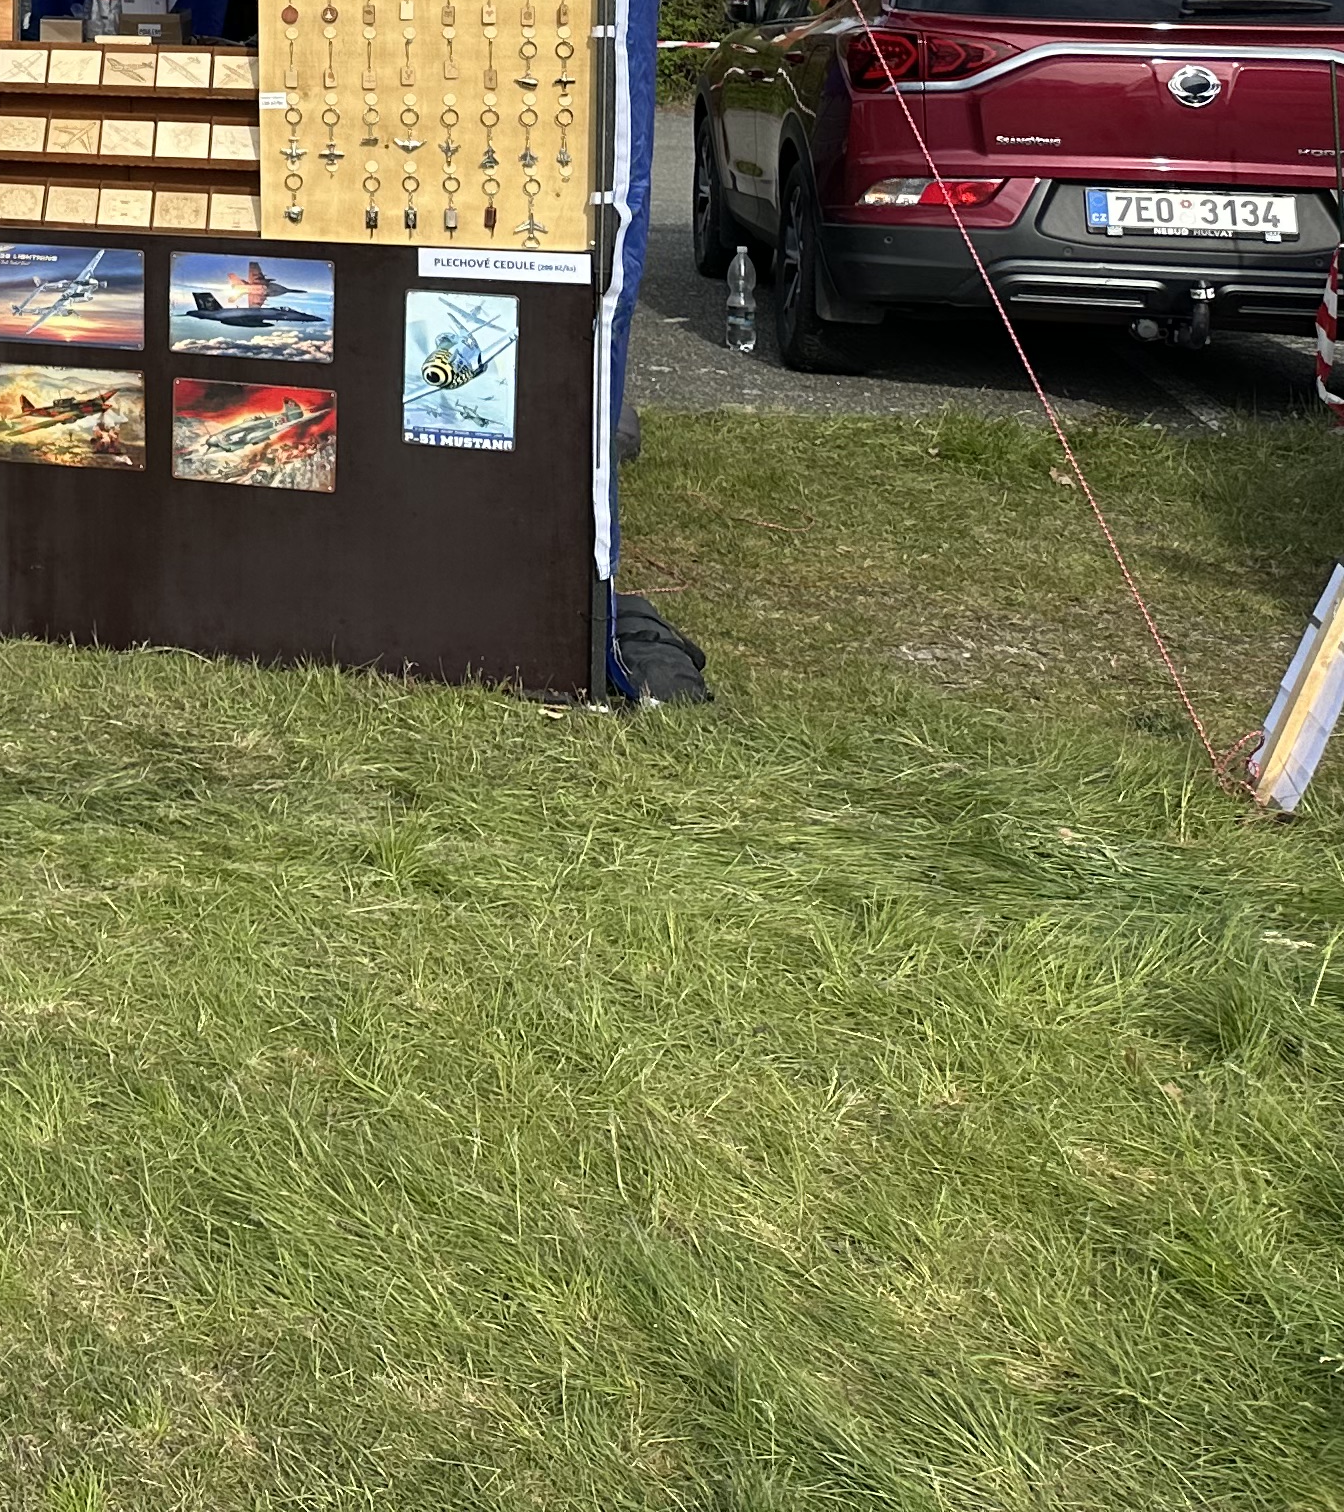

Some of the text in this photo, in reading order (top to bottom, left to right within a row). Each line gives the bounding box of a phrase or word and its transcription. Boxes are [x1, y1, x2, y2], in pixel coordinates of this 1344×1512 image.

[1092, 213, 1108, 223] CZ
[1115, 196, 1281, 228] 7E0 3134
[434, 257, 491, 269] PLECHOVÉ
[493, 260, 535, 271] CEDULE
[404, 432, 436, 446] P-51
